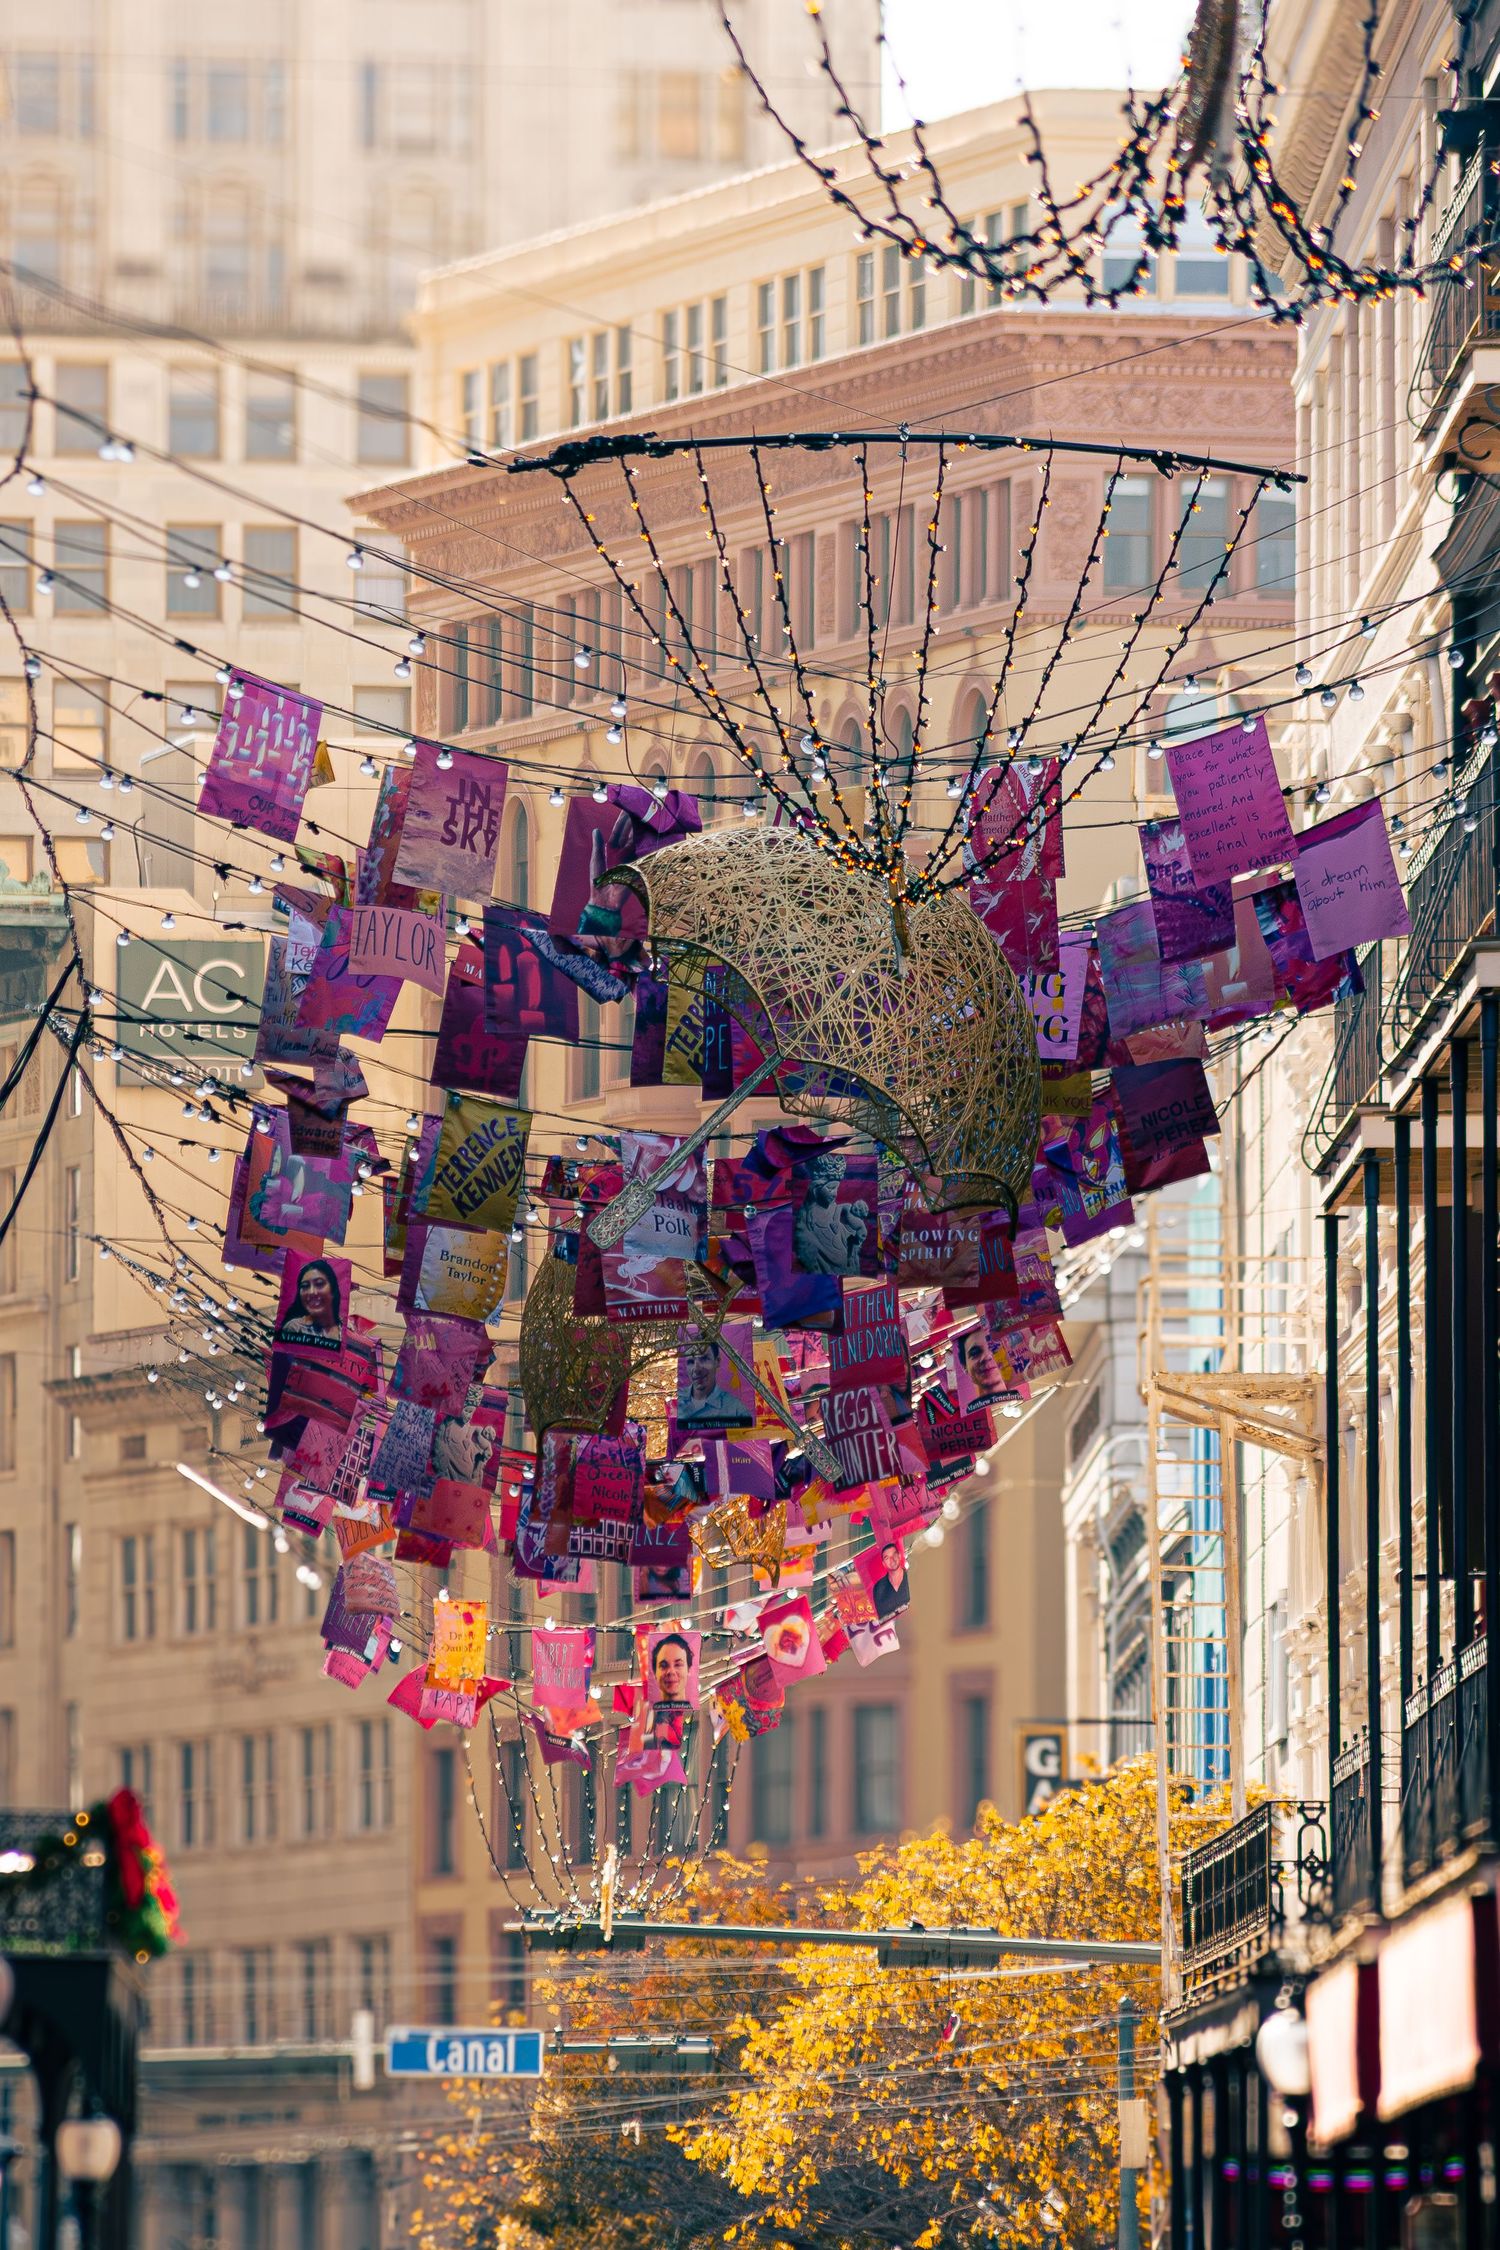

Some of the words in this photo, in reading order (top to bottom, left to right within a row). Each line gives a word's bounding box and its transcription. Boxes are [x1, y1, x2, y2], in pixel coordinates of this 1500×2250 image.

[1210, 739, 1224, 755] be
[1176, 771, 1196, 786] you
[1203, 761, 1219, 773] for
[1228, 746, 1257, 765] what
[458, 778, 491, 810] IN
[1181, 788, 1199, 804] you
[1208, 764, 1265, 797] patiently
[1231, 789, 1255, 808] And
[446, 795, 499, 832] THE
[440, 819, 498, 858] SKY
[1188, 814, 1238, 842] excellent
[1191, 849, 1211, 863] the
[1216, 833, 1248, 855] final
[1321, 864, 1369, 887] dream
[1307, 887, 1345, 911] about
[354, 909, 437, 976] TAYLOR
[140, 959, 246, 1015] AC
[139, 1021, 248, 1040] HOTELS
[1140, 1096, 1209, 1131] NICOLE
[1152, 1114, 1212, 1146] PEREZ
[434, 1116, 521, 1194] TERRENCE
[451, 1131, 527, 1219] KENNEDY
[653, 1213, 692, 1237] Polk
[901, 1229, 979, 1245] GLOWING
[440, 1249, 497, 1274] Brandon
[900, 1246, 954, 1262] SPIRIT
[447, 1266, 487, 1286] Taylor
[617, 1303, 680, 1318] MATTHEW
[843, 1287, 895, 1329] TTHEW
[281, 1333, 309, 1345] Nicole
[314, 1337, 338, 1349] Perez
[829, 1323, 901, 1372] TENEDORIO
[968, 1398, 991, 1411] Matthew
[931, 1419, 981, 1440] NICOLE
[940, 1435, 985, 1455] PEREZ
[926, 1476, 951, 1490] William
[426, 2032, 517, 2073] Canal
